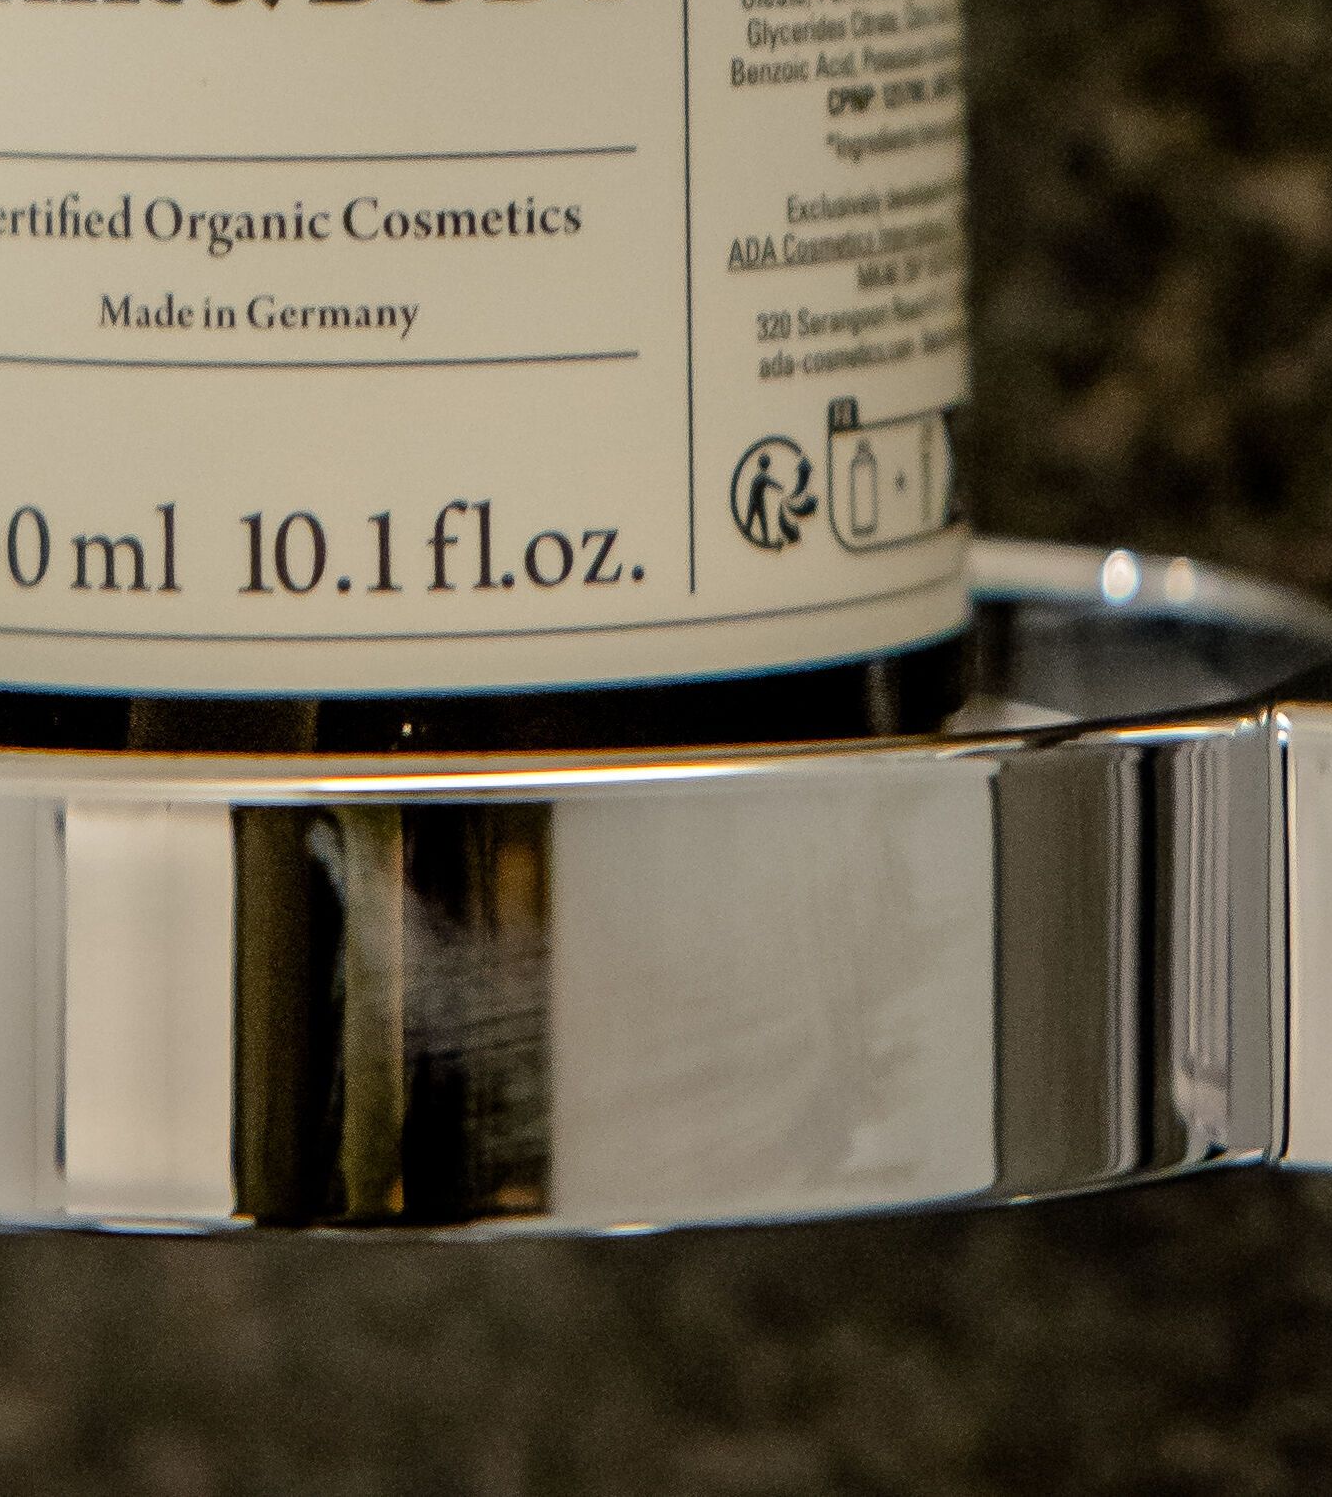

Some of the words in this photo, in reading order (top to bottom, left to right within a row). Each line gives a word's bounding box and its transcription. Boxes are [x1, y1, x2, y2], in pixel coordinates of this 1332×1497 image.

[730, 54, 811, 88] Benzoic
[144, 198, 331, 258] Organic
[342, 195, 583, 241] Cosmetics
[727, 234, 780, 271] ADA
[100, 292, 195, 330] Made
[202, 297, 237, 330] in
[246, 296, 419, 340] Germany
[756, 310, 793, 342] 320
[70, 501, 183, 595] ml
[237, 509, 402, 596] 10.1
[426, 498, 647, 593] fl.oz.
